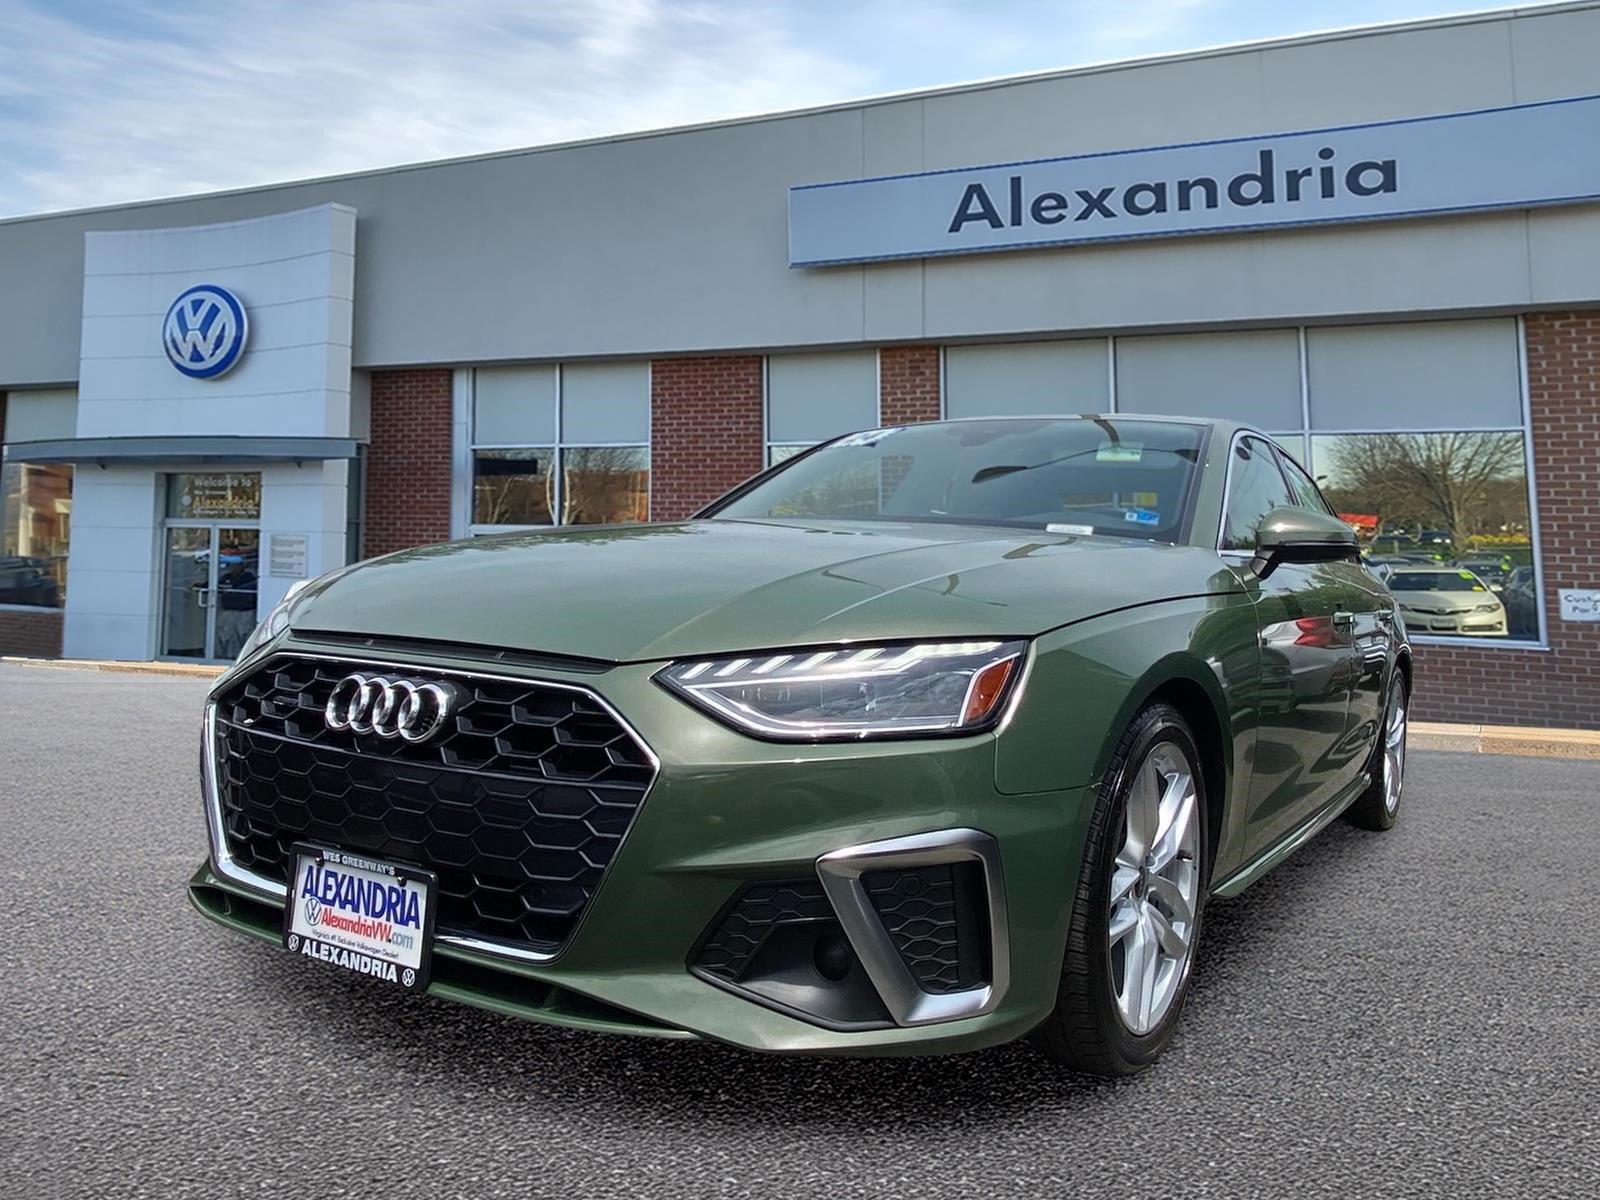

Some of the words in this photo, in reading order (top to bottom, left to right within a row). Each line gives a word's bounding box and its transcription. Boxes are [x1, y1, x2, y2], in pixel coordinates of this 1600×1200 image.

[947, 146, 1397, 233] Alexandria
[168, 290, 238, 371] VW
[194, 478, 239, 487] Welcome
[241, 478, 252, 487] to
[322, 850, 341, 863] WES
[341, 855, 395, 877] GREENWAY'S
[301, 865, 421, 930] ALEXANDRIA
[321, 907, 414, 949] AlexandriaVW.com
[301, 939, 398, 983] ALEXANDRIA
